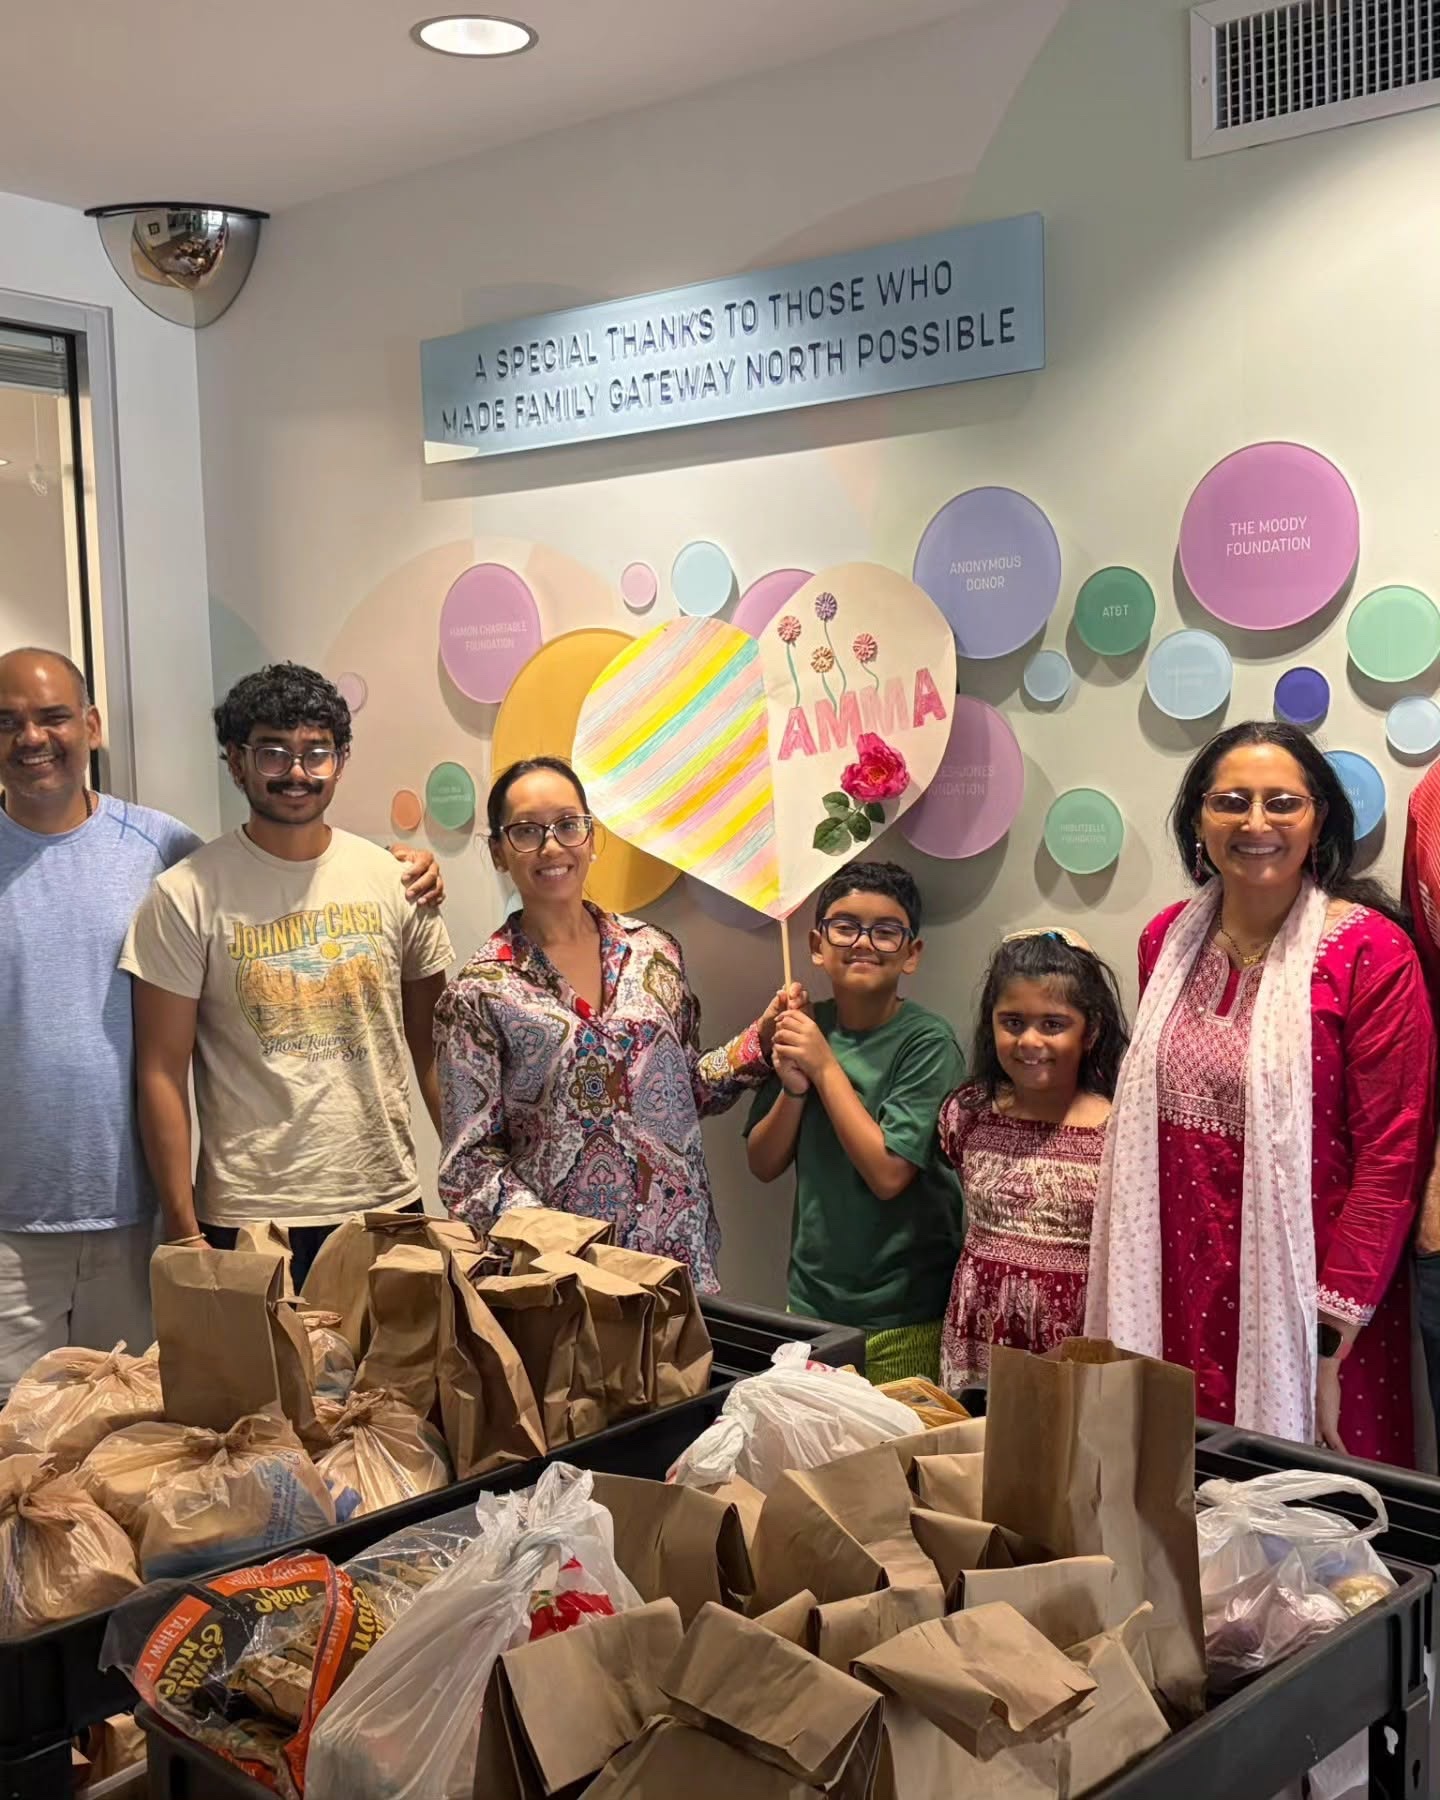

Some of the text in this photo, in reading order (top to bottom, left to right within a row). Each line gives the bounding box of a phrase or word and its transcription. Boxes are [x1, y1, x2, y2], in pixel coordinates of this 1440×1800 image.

[474, 260, 952, 384] A SPECIAL THANKS TO THOSE WHO
[442, 306, 1016, 438] MADE FAMILY GATEWAY NORTH POSSIBLE
[1229, 515, 1307, 536] THE MOODY
[1226, 535, 1311, 557] FOUNDATION
[949, 555, 1022, 575] ANONYMOUS
[965, 575, 1006, 592] DONOR
[1102, 604, 1129, 617] AT&T
[465, 638, 515, 651] FOUNDATION
[777, 667, 948, 761] AMMA
[228, 902, 383, 960] JOHNNY CASH
[262, 1033, 348, 1057] Ghost Riders
[342, 1043, 368, 1062] Sky
[351, 1586, 374, 1651] Own
